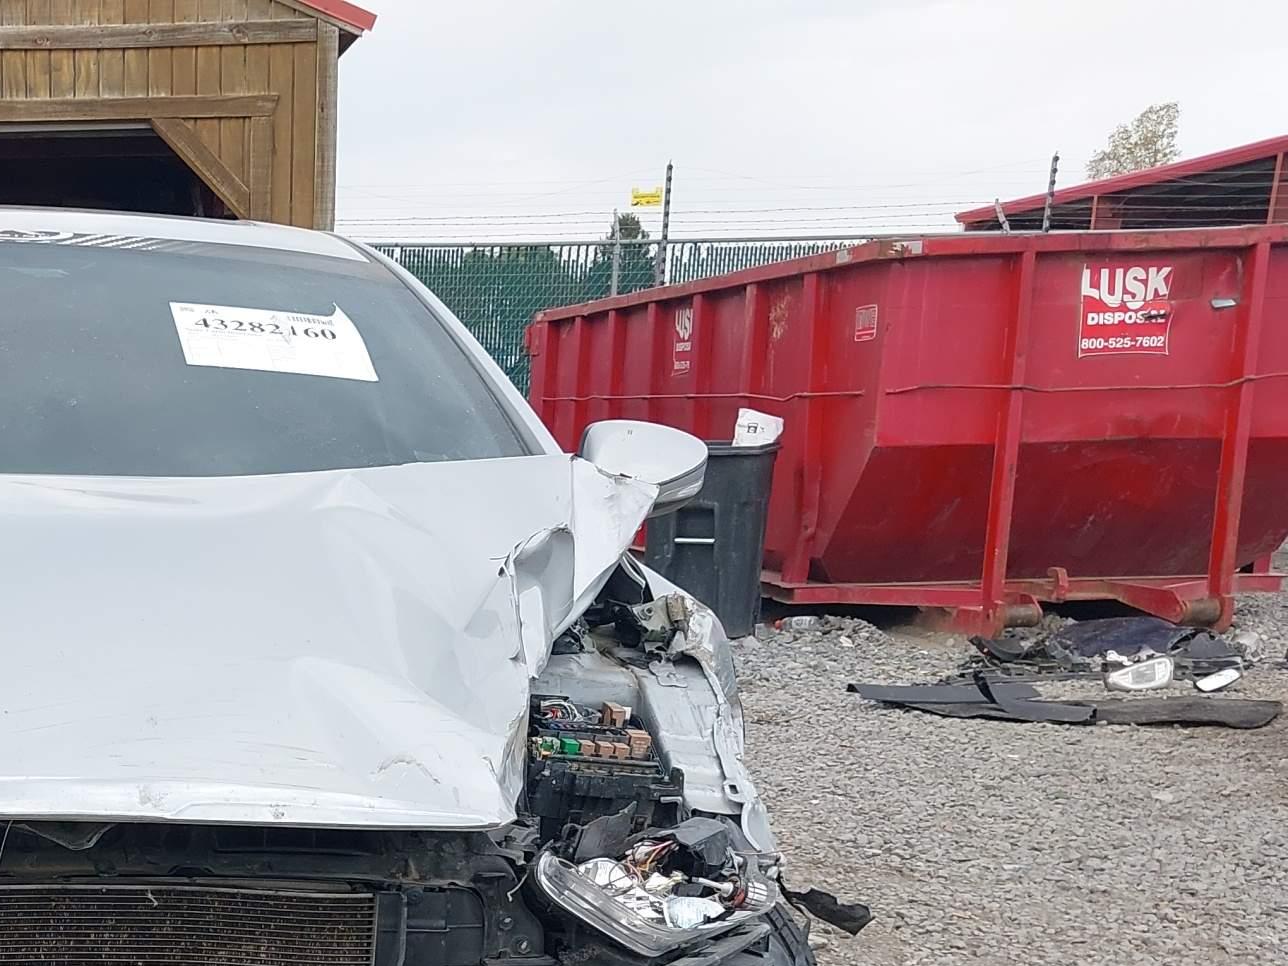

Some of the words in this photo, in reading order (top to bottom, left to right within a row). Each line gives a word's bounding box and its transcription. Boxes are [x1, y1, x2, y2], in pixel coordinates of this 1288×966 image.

[1082, 266, 1172, 309] LUSK
[194, 317, 337, 340] 43282160
[1081, 336, 1165, 349] 800-525-7602
